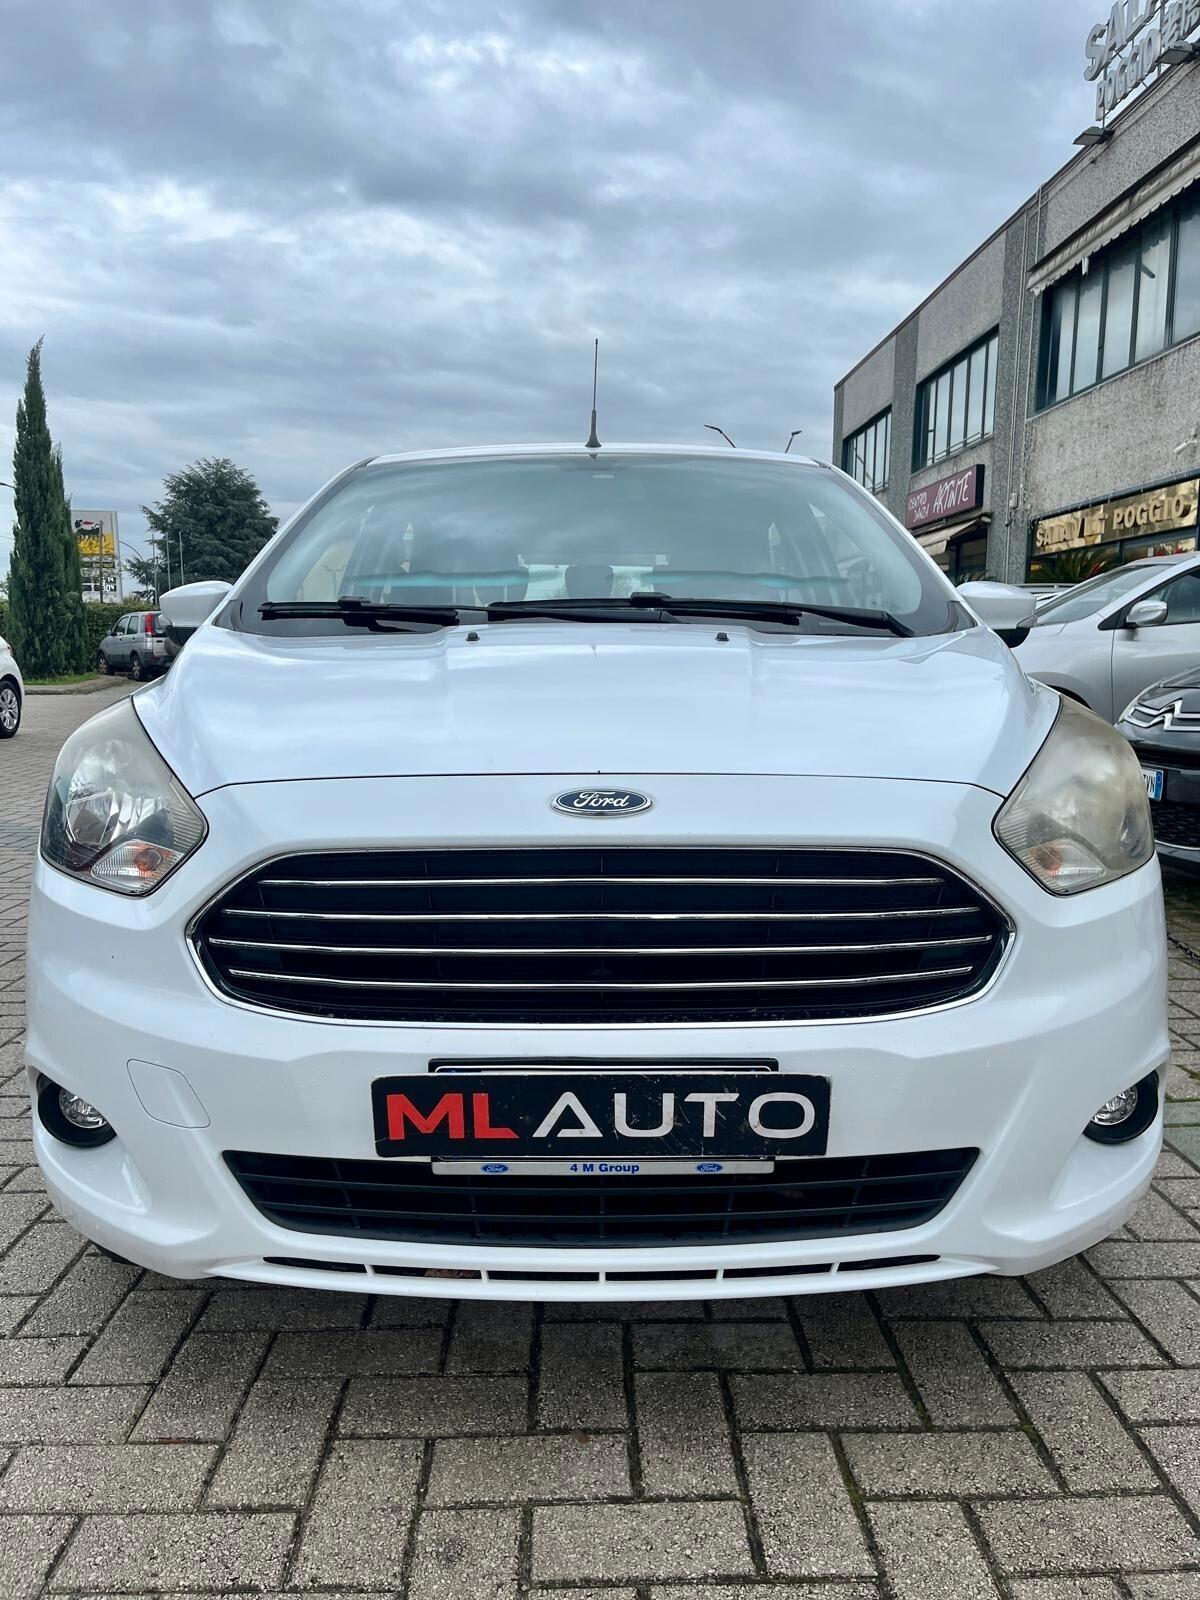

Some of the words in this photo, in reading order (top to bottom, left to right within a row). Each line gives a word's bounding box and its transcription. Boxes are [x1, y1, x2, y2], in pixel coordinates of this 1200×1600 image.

[1096, 29, 1161, 121] POGGIO
[908, 491, 927, 511] CENTRO
[1112, 496, 1185, 530] POGGIO
[573, 791, 629, 807] Ford
[386, 1092, 519, 1141] ML
[532, 1091, 816, 1139] AUTO
[570, 1163, 578, 1173] 4
[583, 1163, 594, 1173] M
[599, 1163, 640, 1174] Group
